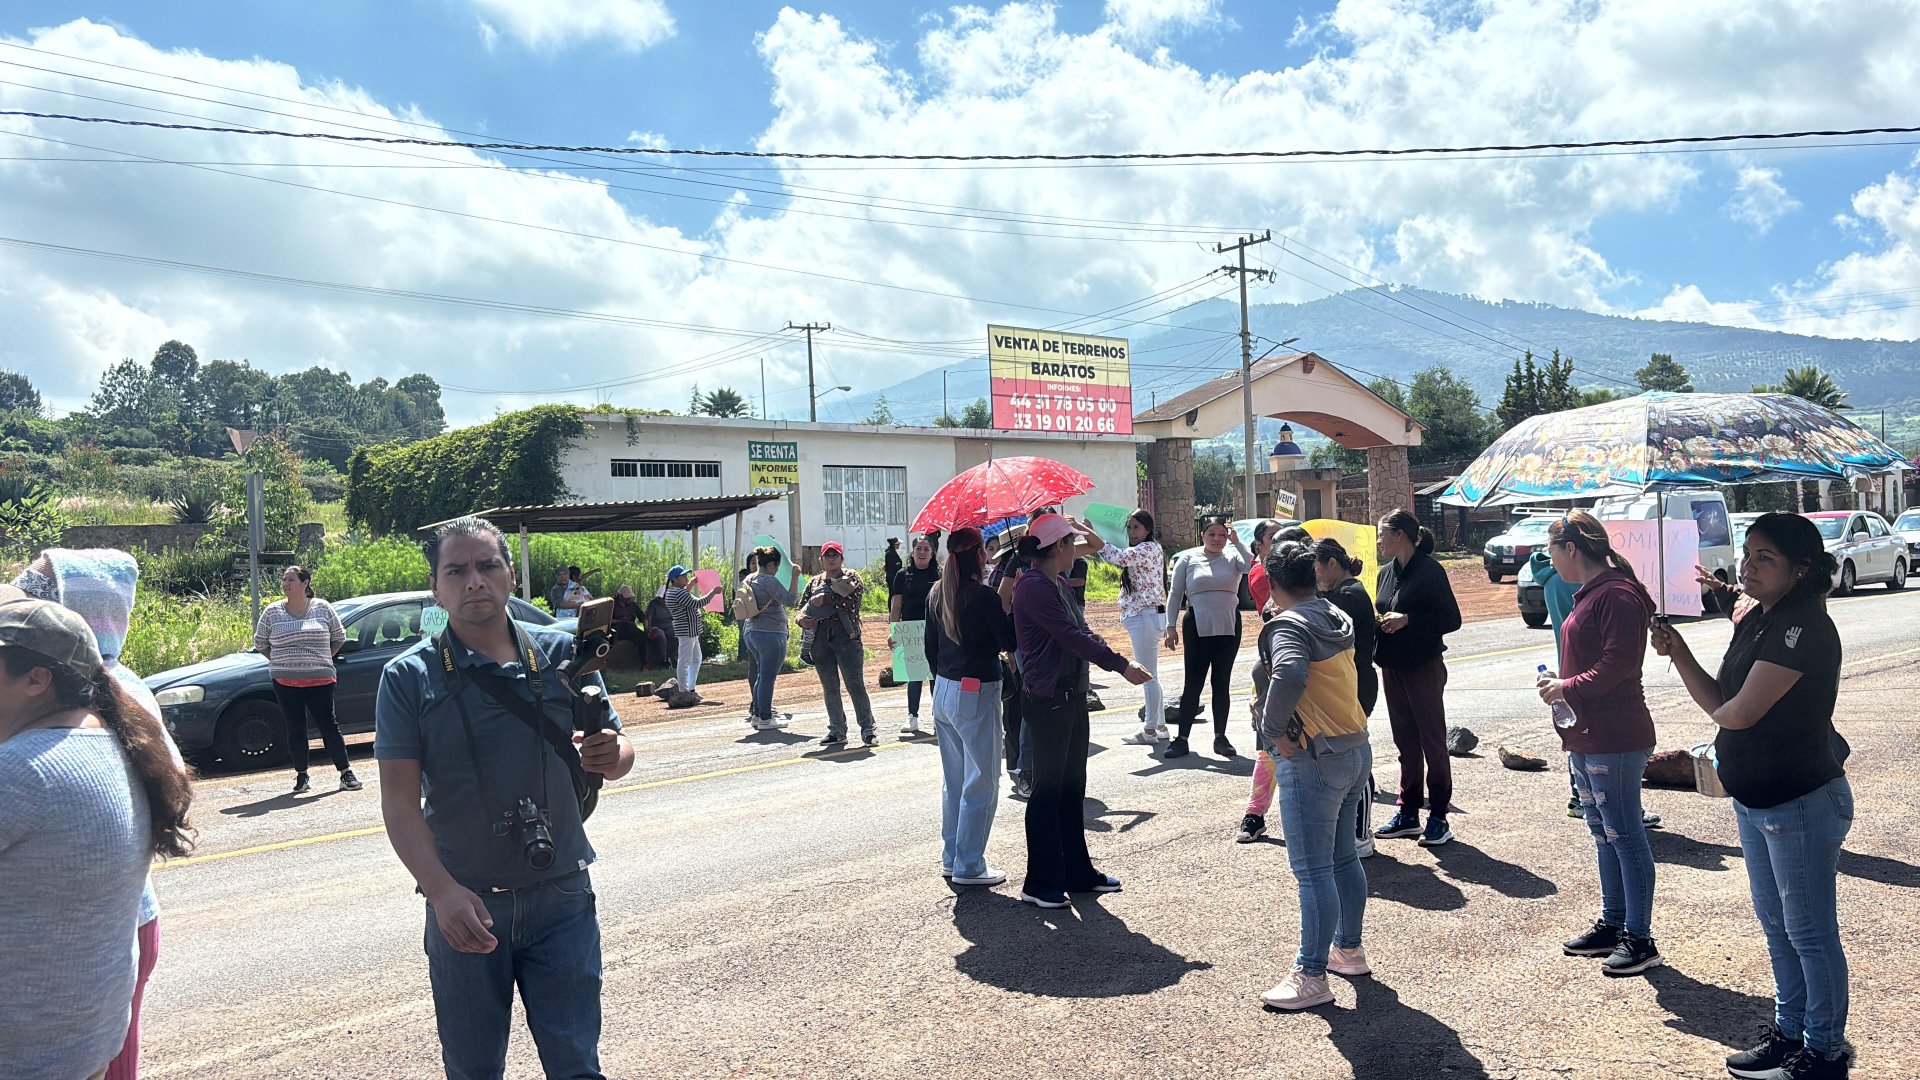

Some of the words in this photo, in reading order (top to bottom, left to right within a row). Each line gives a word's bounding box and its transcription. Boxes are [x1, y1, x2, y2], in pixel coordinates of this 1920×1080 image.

[994, 335, 1039, 352] VENTA
[1042, 340, 1060, 353] DE
[1062, 341, 1126, 359] TERRENOS
[1031, 361, 1096, 379] BARATOS
[1047, 383, 1082, 392] INFORMES:
[1009, 392, 1032, 409] 44
[1034, 393, 1050, 410] 31
[1053, 395, 1073, 411] 78
[1076, 396, 1095, 413] 05
[1098, 397, 1117, 414] 00
[1013, 413, 1032, 429] 33
[1036, 414, 1052, 430] 19
[1056, 415, 1071, 431] 01
[1075, 416, 1093, 432] 20
[1096, 417, 1115, 433] 66
[751, 443, 762, 459] SE
[764, 444, 796, 459] RENTA
[751, 464, 798, 472] INFORMES
[758, 476, 771, 484] AL
[1278, 492, 1295, 506] VENTA
[894, 624, 909, 634] NO
[443, 647, 454, 672] Nikon
[528, 648, 539, 672] Nikon
